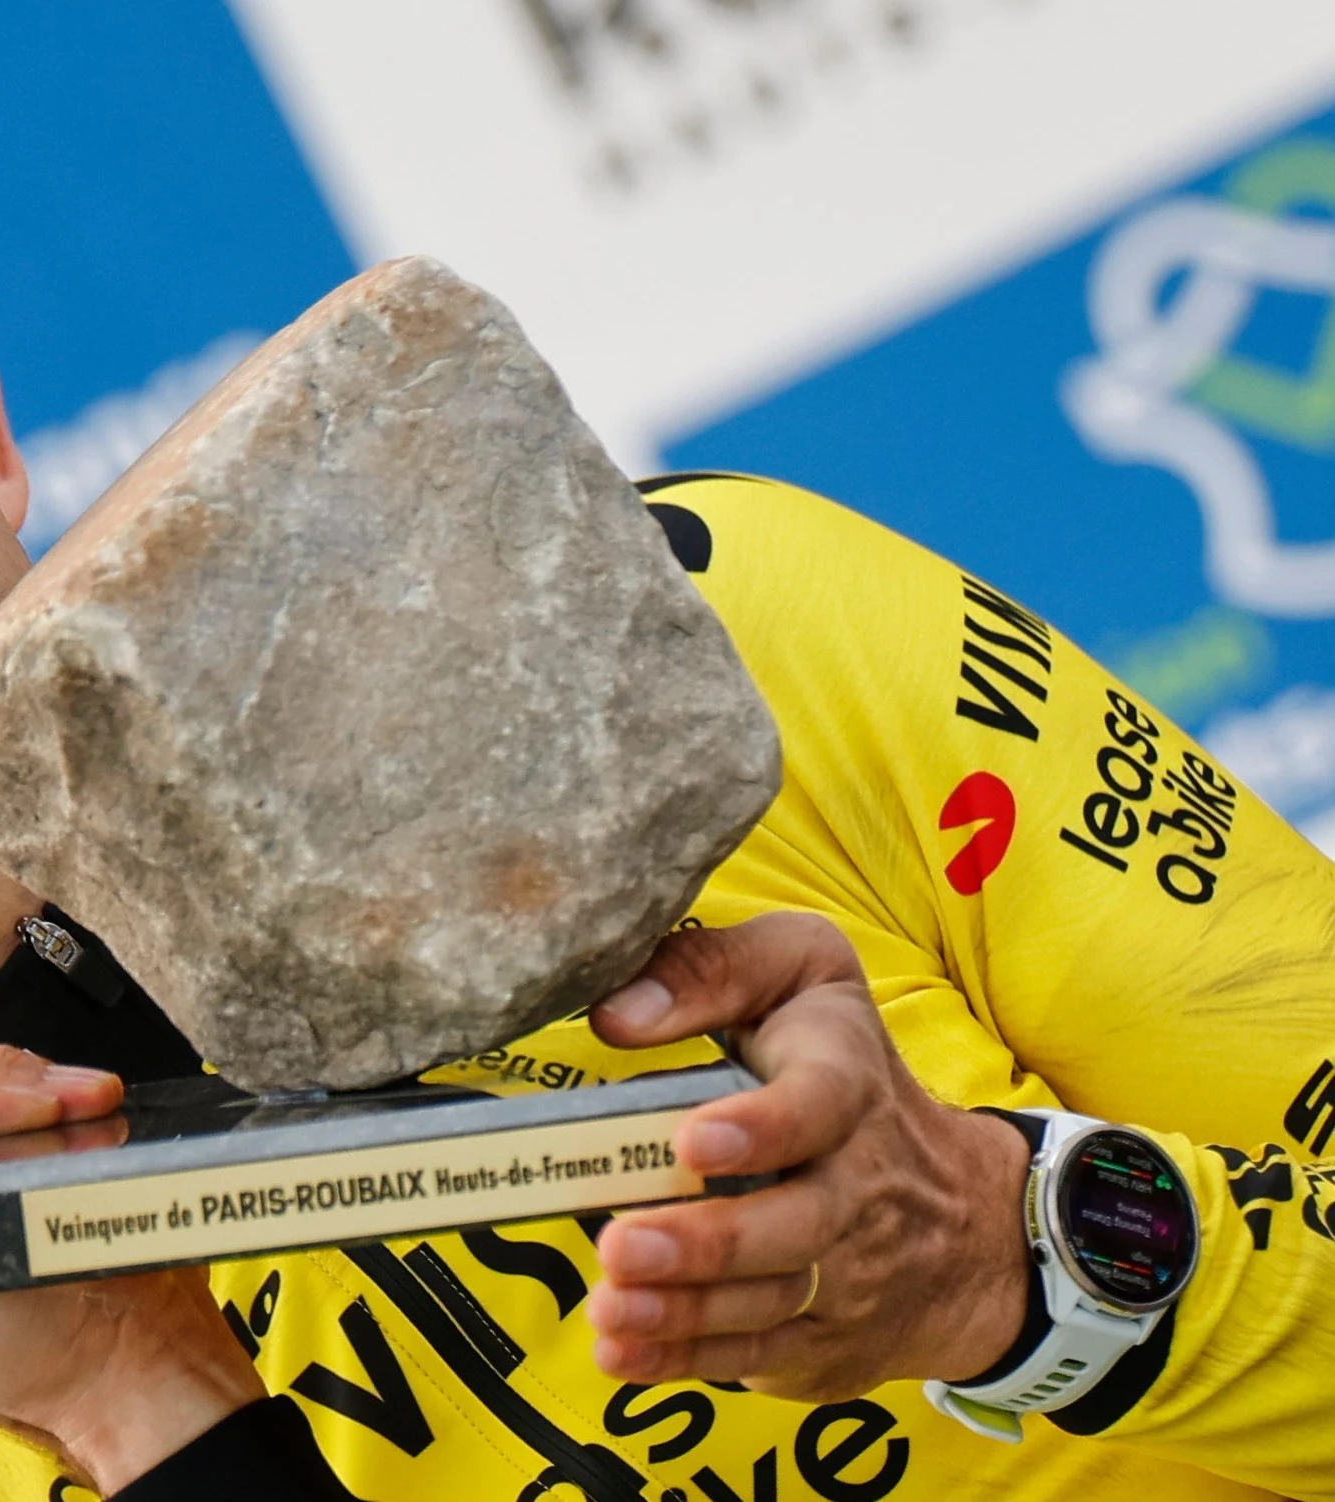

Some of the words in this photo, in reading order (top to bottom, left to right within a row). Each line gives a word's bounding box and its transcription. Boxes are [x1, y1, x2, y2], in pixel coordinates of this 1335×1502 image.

[956, 574, 1052, 743] VISM
[1059, 689, 1160, 873] lease
[45, 1212, 158, 1245] Vainqueur
[167, 1201, 193, 1230] de
[201, 1168, 426, 1225] PARIS-ROUBAIX
[435, 1154, 613, 1195] Hauts-de-France
[620, 1140, 676, 1172] 2026
